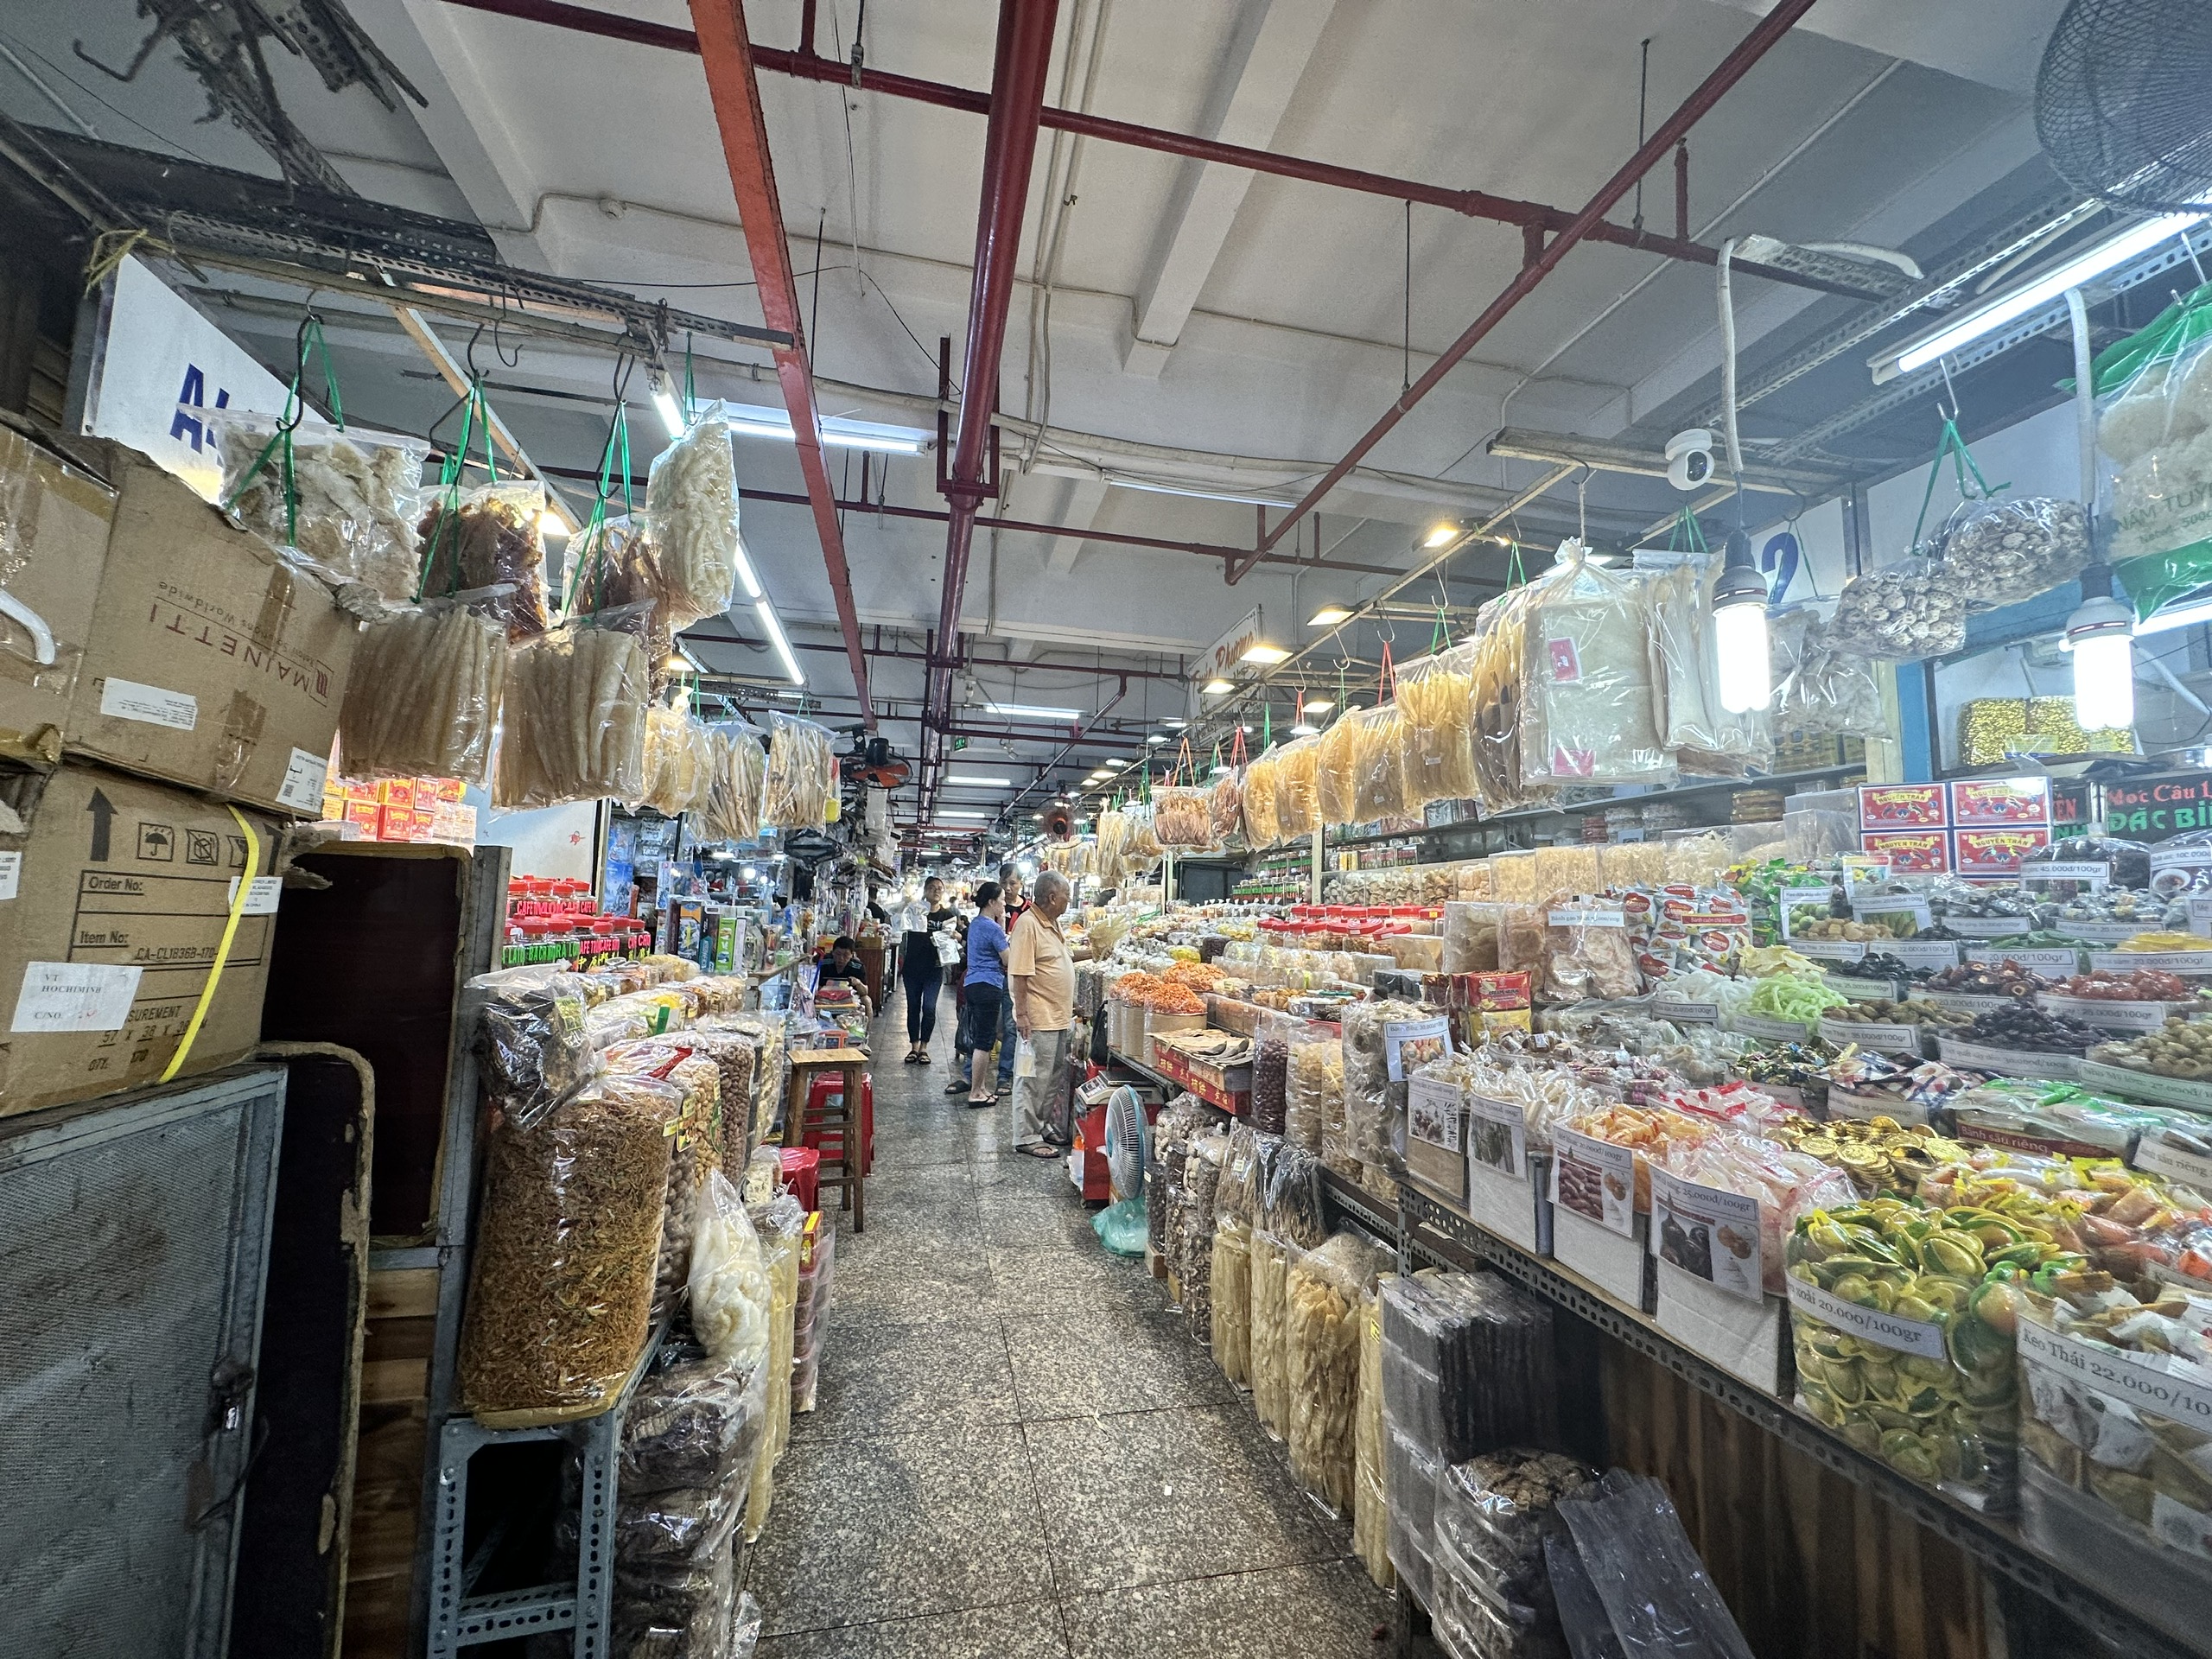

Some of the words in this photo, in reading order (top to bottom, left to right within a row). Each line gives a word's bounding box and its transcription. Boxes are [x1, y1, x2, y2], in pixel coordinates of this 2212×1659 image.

[149, 603, 310, 692] MAINETTI
[2154, 785, 2196, 803] Câu
[88, 875, 122, 891] Order
[125, 877, 143, 891] No:
[80, 930, 105, 944] Item
[110, 931, 129, 944] No:
[41, 985, 102, 994] HOCHIMINH
[127, 1005, 182, 1023] SUREMENT
[2012, 1136, 2050, 1154] riêng
[1796, 1288, 1816, 1305] xoài
[1818, 1299, 1923, 1343] 20.000/100gr
[2047, 1341, 2086, 1370] Thái
[2090, 1361, 2212, 1417] 22.000/10
